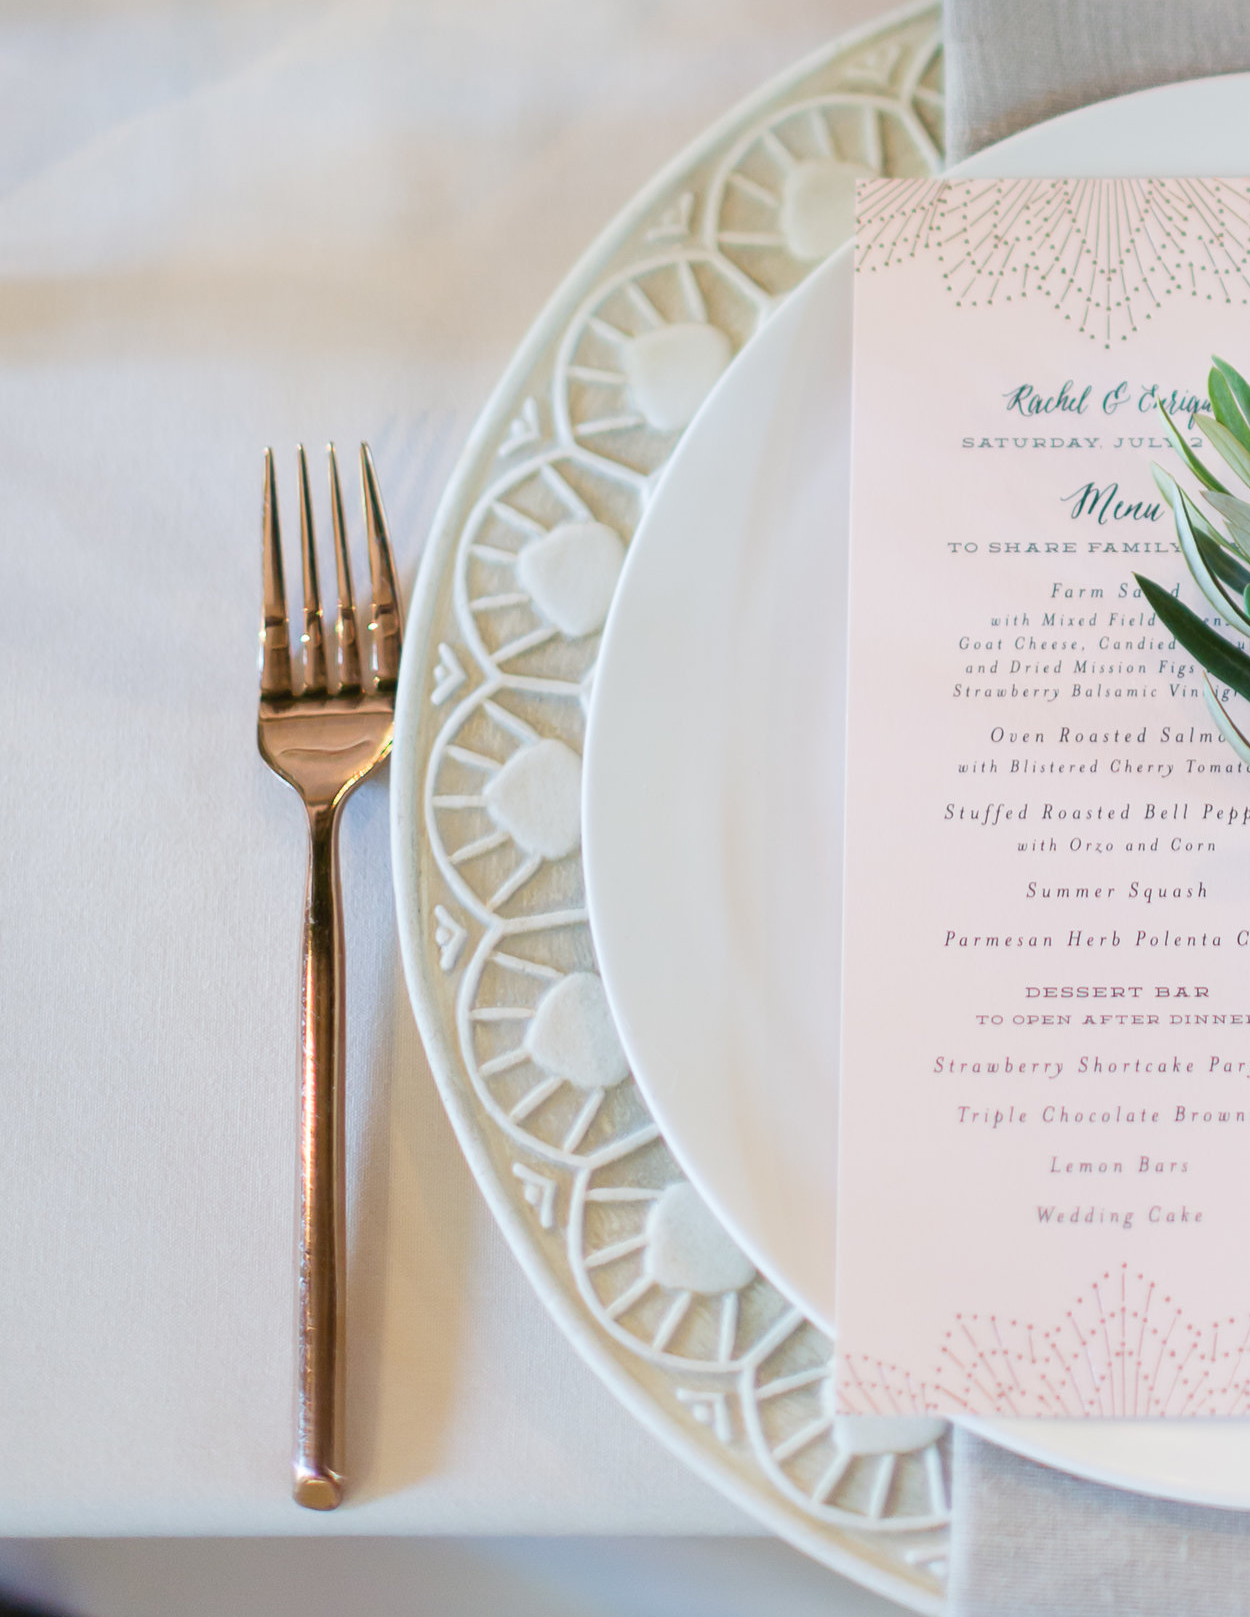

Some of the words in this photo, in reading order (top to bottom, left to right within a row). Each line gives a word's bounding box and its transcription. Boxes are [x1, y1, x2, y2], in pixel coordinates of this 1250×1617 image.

[1002, 379, 1092, 417] Rachel
[1102, 380, 1131, 415] &
[1138, 383, 1212, 430] Enriqu
[1060, 481, 1165, 525] Menu
[947, 541, 978, 554] TO
[989, 541, 1077, 554] SHARE
[1088, 541, 1182, 554] FAMILY
[1050, 582, 1104, 599] Farm
[1118, 582, 1180, 599] Sad
[991, 612, 1029, 627] with
[1042, 612, 1097, 627] Mixed
[1109, 612, 1157, 627] Field
[959, 636, 1002, 651] Goat
[1015, 635, 1086, 655] Cheese,
[1099, 636, 1177, 651] Candied
[966, 659, 998, 675] and
[1010, 659, 1062, 674] Dried
[1073, 659, 1147, 674] Mission
[1159, 660, 1195, 679] Figs
[953, 683, 1060, 703] Strawberry
[1072, 683, 1157, 698] Balsamic
[991, 726, 1044, 744] Oven
[1059, 726, 1147, 744] Roasted
[1160, 726, 1228, 744] Salmo
[958, 758, 997, 774] with
[1009, 758, 1099, 774] Blistered
[1110, 758, 1174, 779] Cherry
[944, 802, 1029, 827] Stuffed
[1042, 802, 1131, 821] Roasted
[1144, 802, 1188, 821] Bell
[1018, 837, 1057, 852] with
[1070, 837, 1114, 853] Orzo
[1126, 837, 1159, 853] and
[1171, 836, 1216, 853] Corn
[1026, 881, 1115, 899] Summer
[1129, 881, 1207, 904] Squash
[944, 929, 1052, 948] Parmesan
[1067, 929, 1121, 948] Herb
[1136, 929, 1221, 948] Polenta
[1025, 986, 1143, 999] DESSERT
[1155, 986, 1210, 999] BAR
[976, 1014, 1004, 1026] TO
[1012, 1014, 1072, 1026] OPEN
[1082, 1014, 1160, 1026] AFTER
[933, 1055, 1064, 1080] Strawberry
[1078, 1055, 1194, 1074] Shortcake
[958, 1105, 1027, 1129] Triple
[1042, 1105, 1159, 1124] Chocolate
[1050, 1155, 1123, 1174] Lemon
[1138, 1155, 1188, 1174] Bars
[1036, 1205, 1135, 1230] Wedding
[1149, 1205, 1203, 1224] Cake
